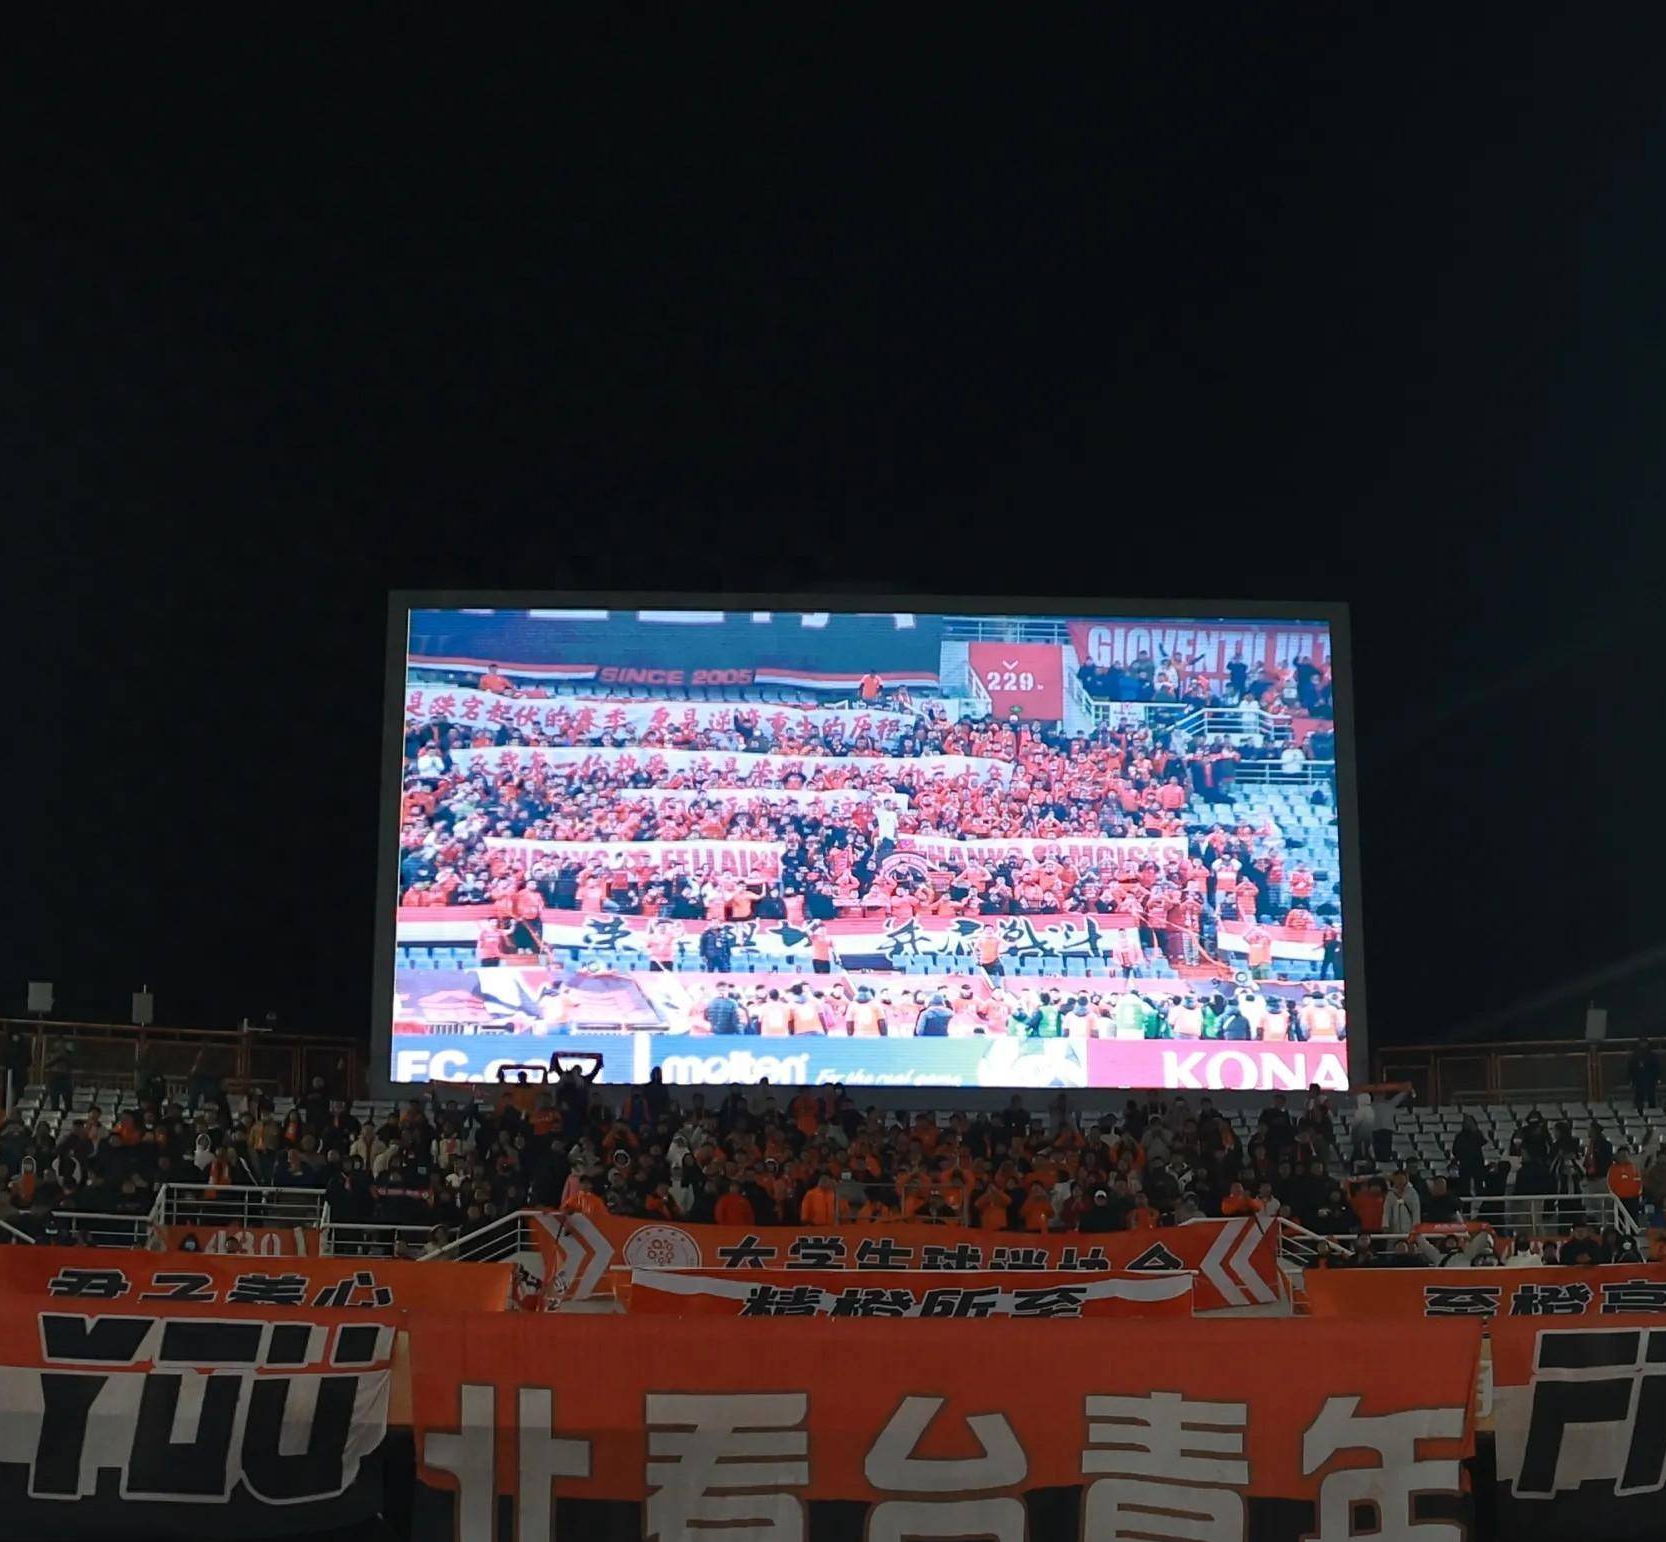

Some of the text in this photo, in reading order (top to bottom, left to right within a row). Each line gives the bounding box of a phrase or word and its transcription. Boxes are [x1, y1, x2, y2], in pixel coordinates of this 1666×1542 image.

[598, 666, 754, 687] SINCE 2005
[986, 671, 1034, 692] 229
[662, 1051, 810, 1086] molten
[27, 1312, 397, 1505] YOU
